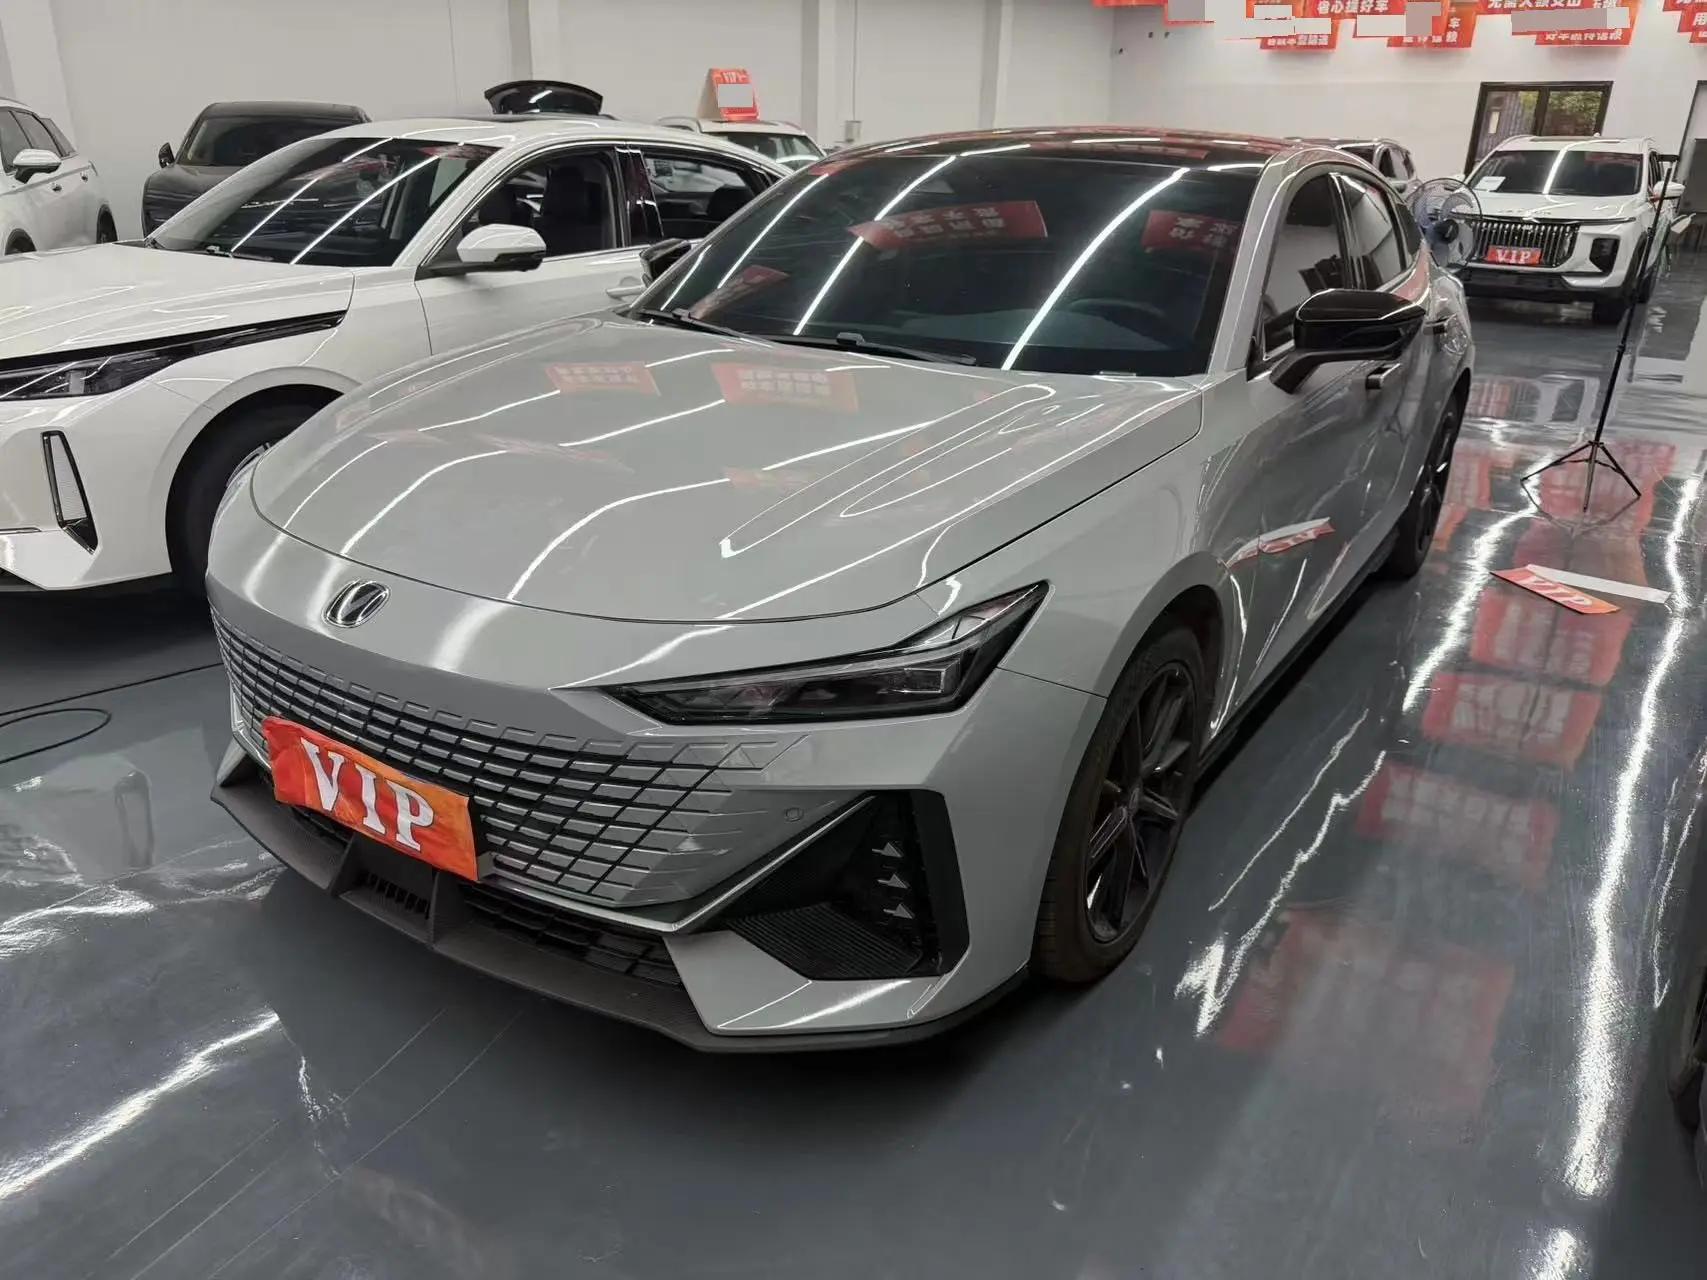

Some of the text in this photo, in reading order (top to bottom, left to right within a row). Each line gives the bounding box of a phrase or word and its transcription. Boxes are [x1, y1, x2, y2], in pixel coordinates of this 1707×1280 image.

[1496, 248, 1531, 264] VIP
[1520, 575, 1593, 606] VIP
[300, 737, 434, 851] VIP
